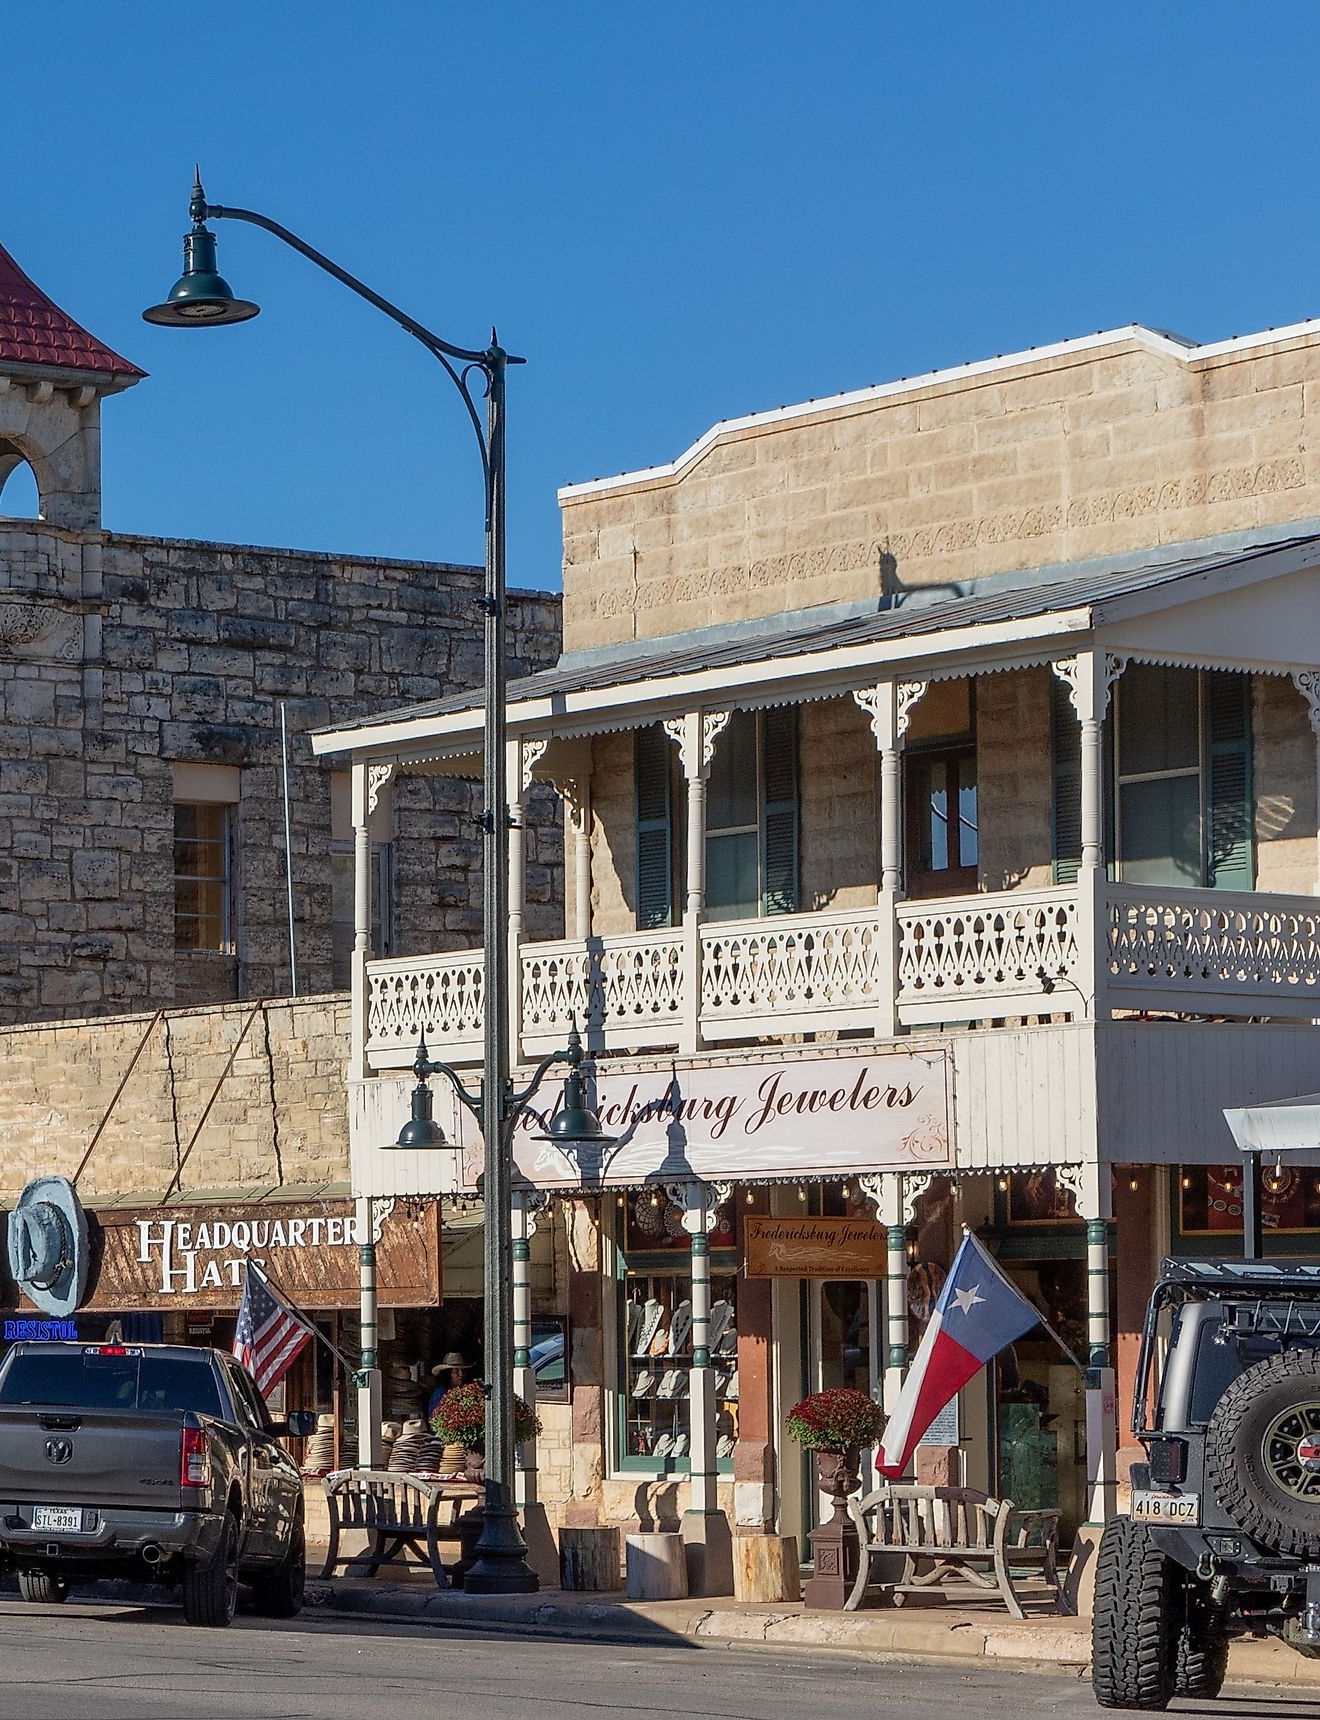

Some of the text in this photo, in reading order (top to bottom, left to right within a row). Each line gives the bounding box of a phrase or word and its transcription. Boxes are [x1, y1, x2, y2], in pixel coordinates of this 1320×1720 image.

[745, 1068, 924, 1135] Jewelers
[136, 1217, 361, 1262] HEADQUARTER
[750, 1222, 837, 1247] Fredericksburg
[4, 1320, 78, 1340] RESISTOL
[1136, 1500, 1195, 1517] 418 DCZ
